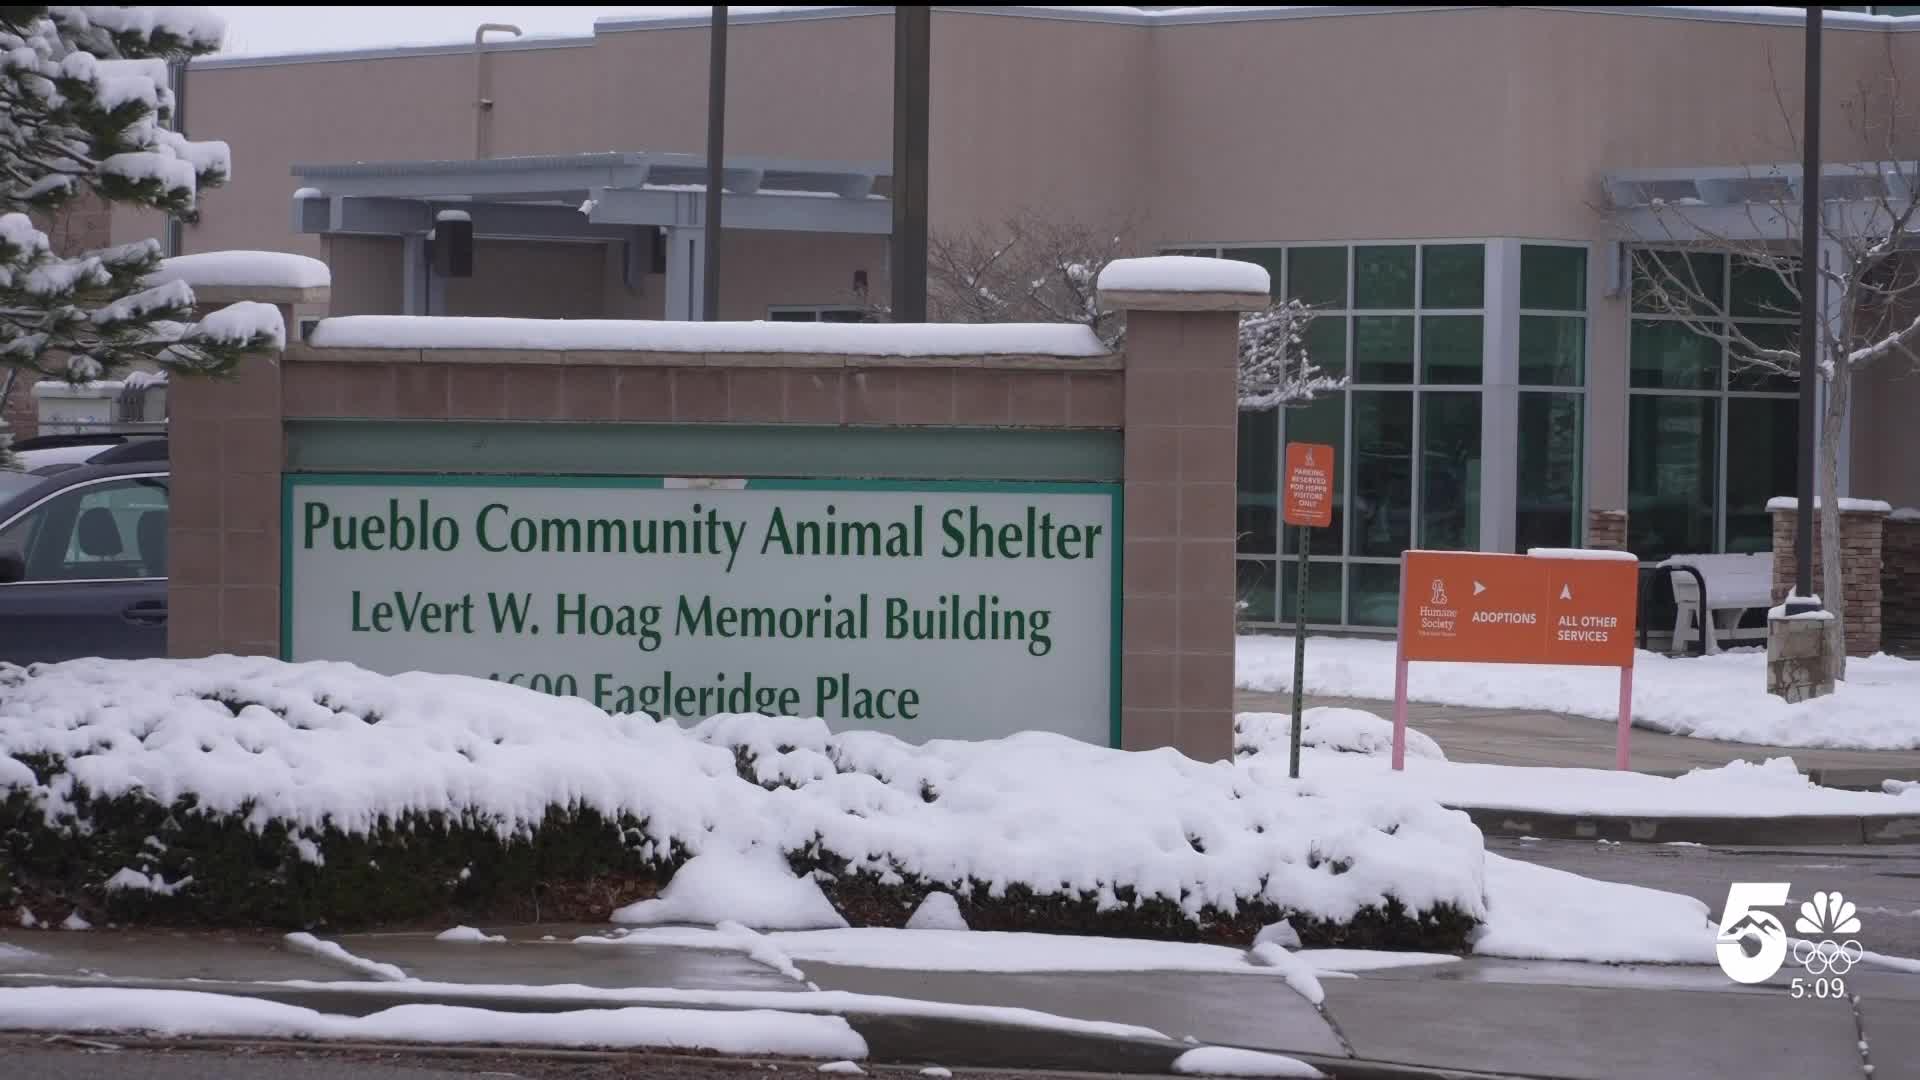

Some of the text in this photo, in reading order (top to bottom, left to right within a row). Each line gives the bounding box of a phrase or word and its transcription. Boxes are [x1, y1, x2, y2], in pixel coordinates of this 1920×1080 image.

[1295, 468, 1324, 476] PARKING
[1292, 476, 1326, 484] RESERVED
[1294, 492, 1322, 500] VISITORS
[304, 499, 1102, 573] Pueblo Community Animal Shelter
[1420, 606, 1457, 617] Humane
[351, 590, 1052, 656] LeVert W. Hoag Memorial Building
[1472, 612, 1537, 624] ADOPTIONS
[1558, 616, 1617, 628] ALL OTHER
[1422, 618, 1454, 631] Society
[1558, 630, 1608, 642] SERVICES
[595, 671, 800, 721] Eagleridge
[816, 673, 919, 720] Place
